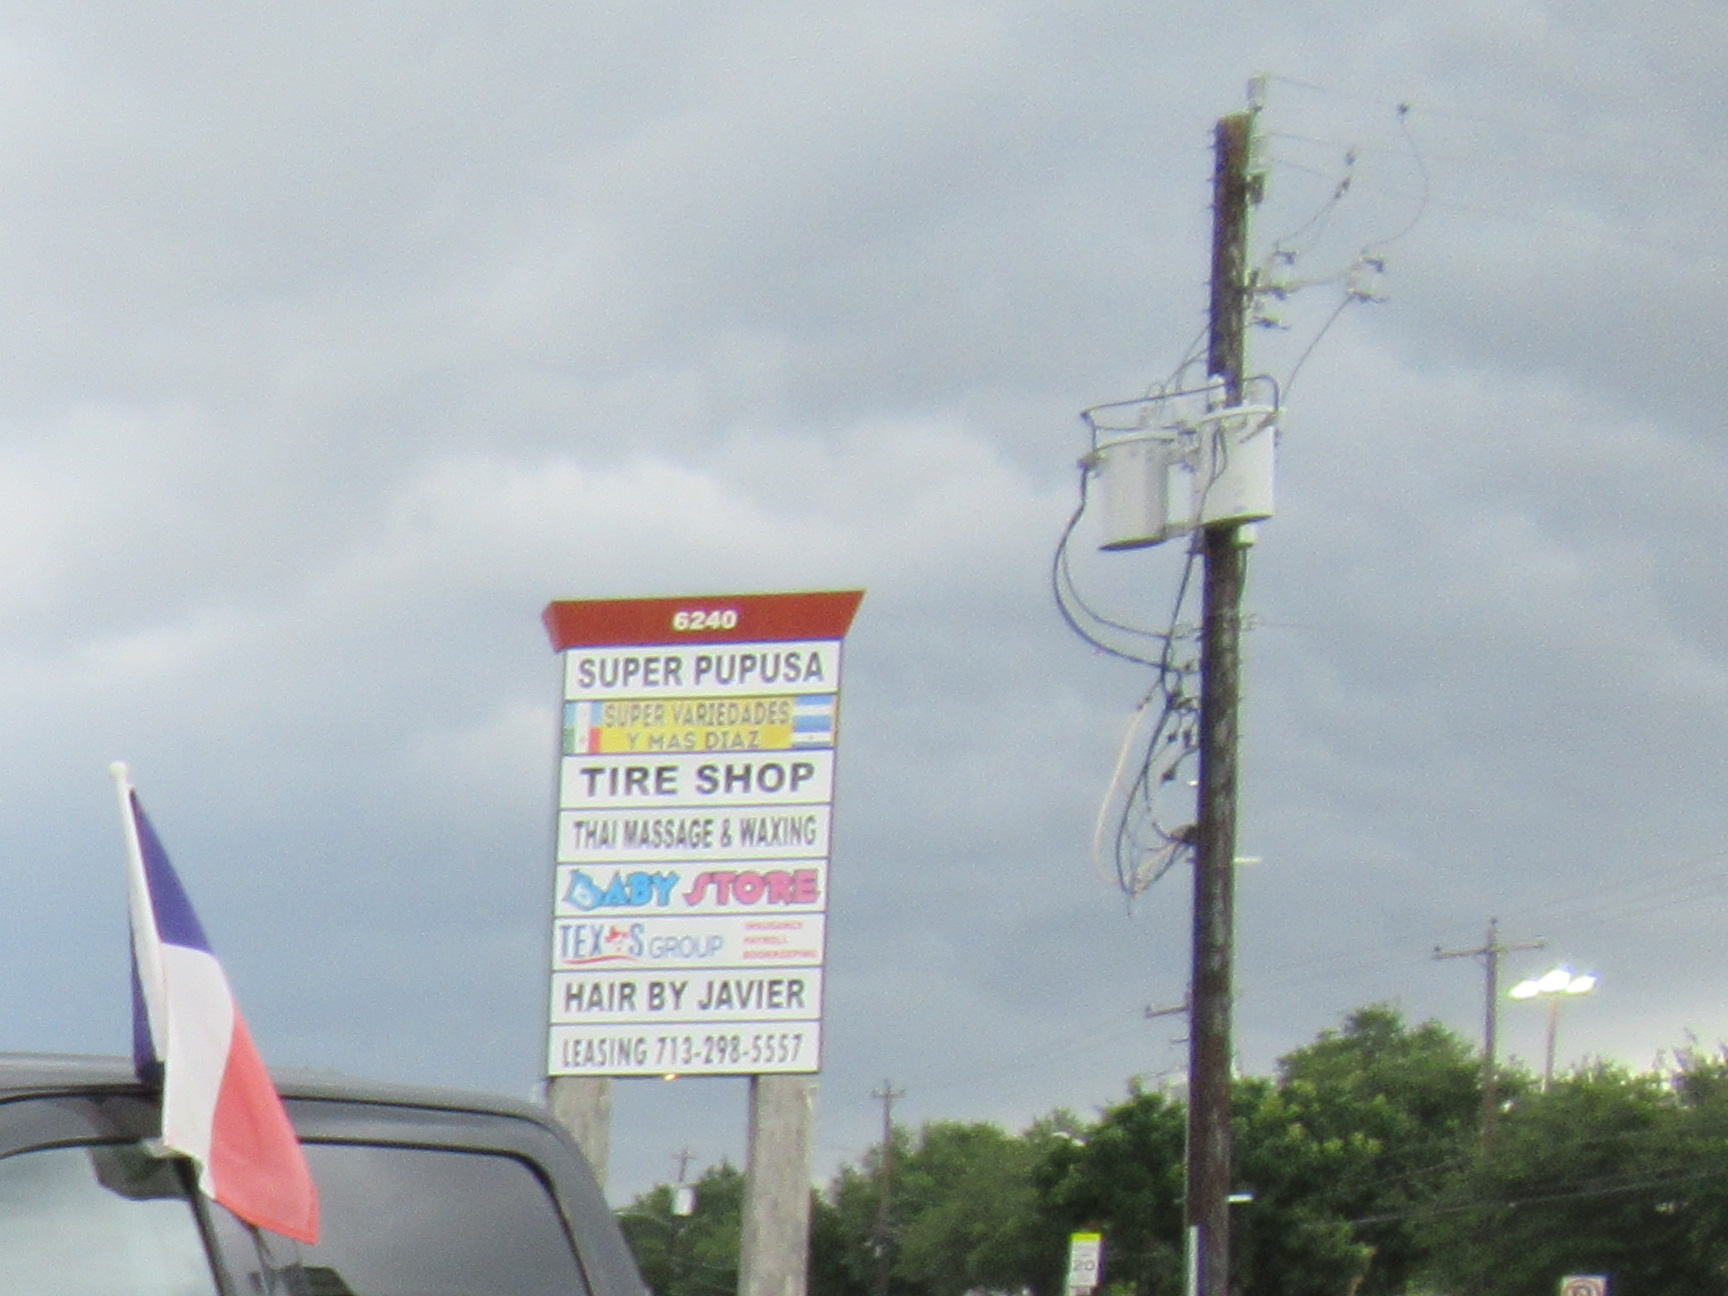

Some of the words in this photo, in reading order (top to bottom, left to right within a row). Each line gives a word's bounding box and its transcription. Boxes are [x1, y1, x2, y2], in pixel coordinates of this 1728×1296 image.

[673, 609, 738, 631] 6240
[578, 656, 683, 689] SUPER
[694, 651, 824, 685] PUPUSA
[604, 702, 665, 727] SUPER
[671, 700, 790, 726] VARIEDADES
[627, 732, 640, 750] Y
[648, 731, 696, 750] MAS
[705, 730, 760, 749] DIAZ
[580, 766, 679, 797] TIRE
[696, 762, 815, 795] SHOP
[574, 820, 617, 849] THAI
[625, 818, 714, 848] MASSAGE
[721, 818, 733, 846] &
[740, 815, 817, 847] WAXING
[682, 868, 821, 907] STORE
[649, 935, 724, 959] GROUP
[564, 981, 637, 1012] HAIR
[648, 981, 689, 1011] BY
[698, 979, 806, 1011] JAVIER
[562, 1036, 647, 1068] LEASING
[655, 1033, 804, 1066] 713-298-5557
